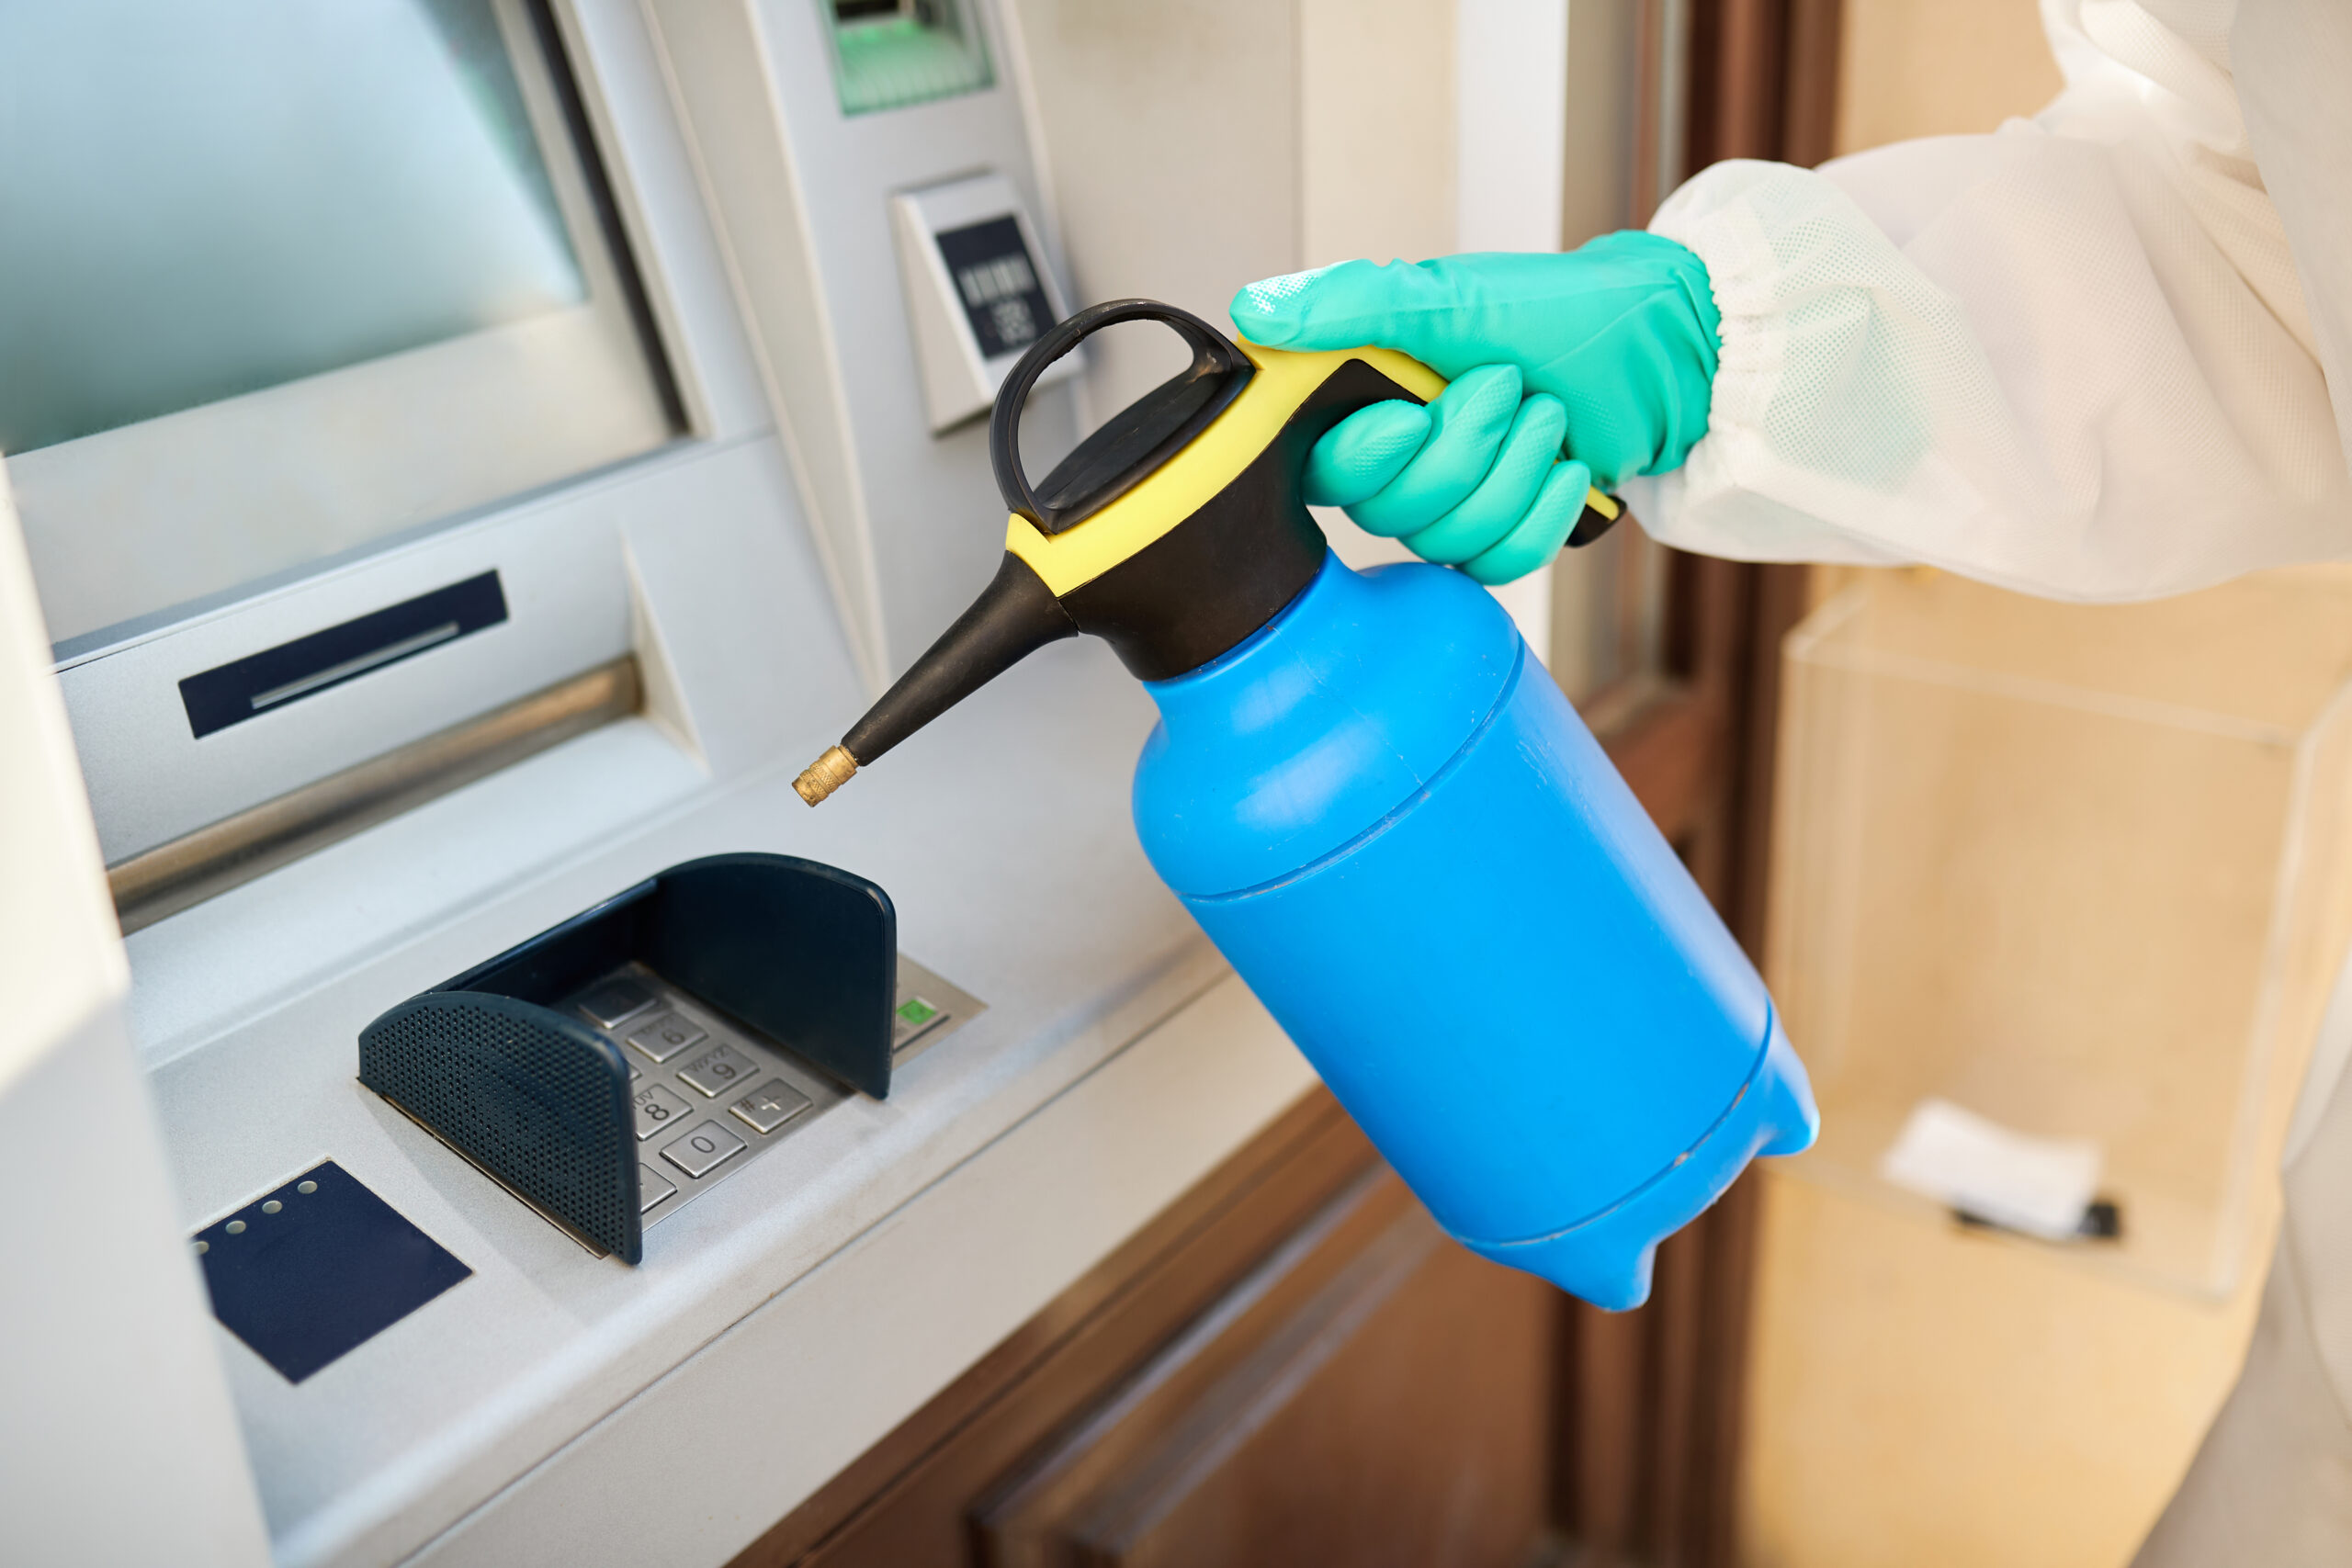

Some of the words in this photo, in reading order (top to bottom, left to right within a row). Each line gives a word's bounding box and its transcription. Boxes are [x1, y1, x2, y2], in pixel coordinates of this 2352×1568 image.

[662, 1027, 686, 1045] 6
[712, 1062, 737, 1080] 9
[644, 1103, 670, 1121] 8
[691, 1135, 716, 1154] 0
